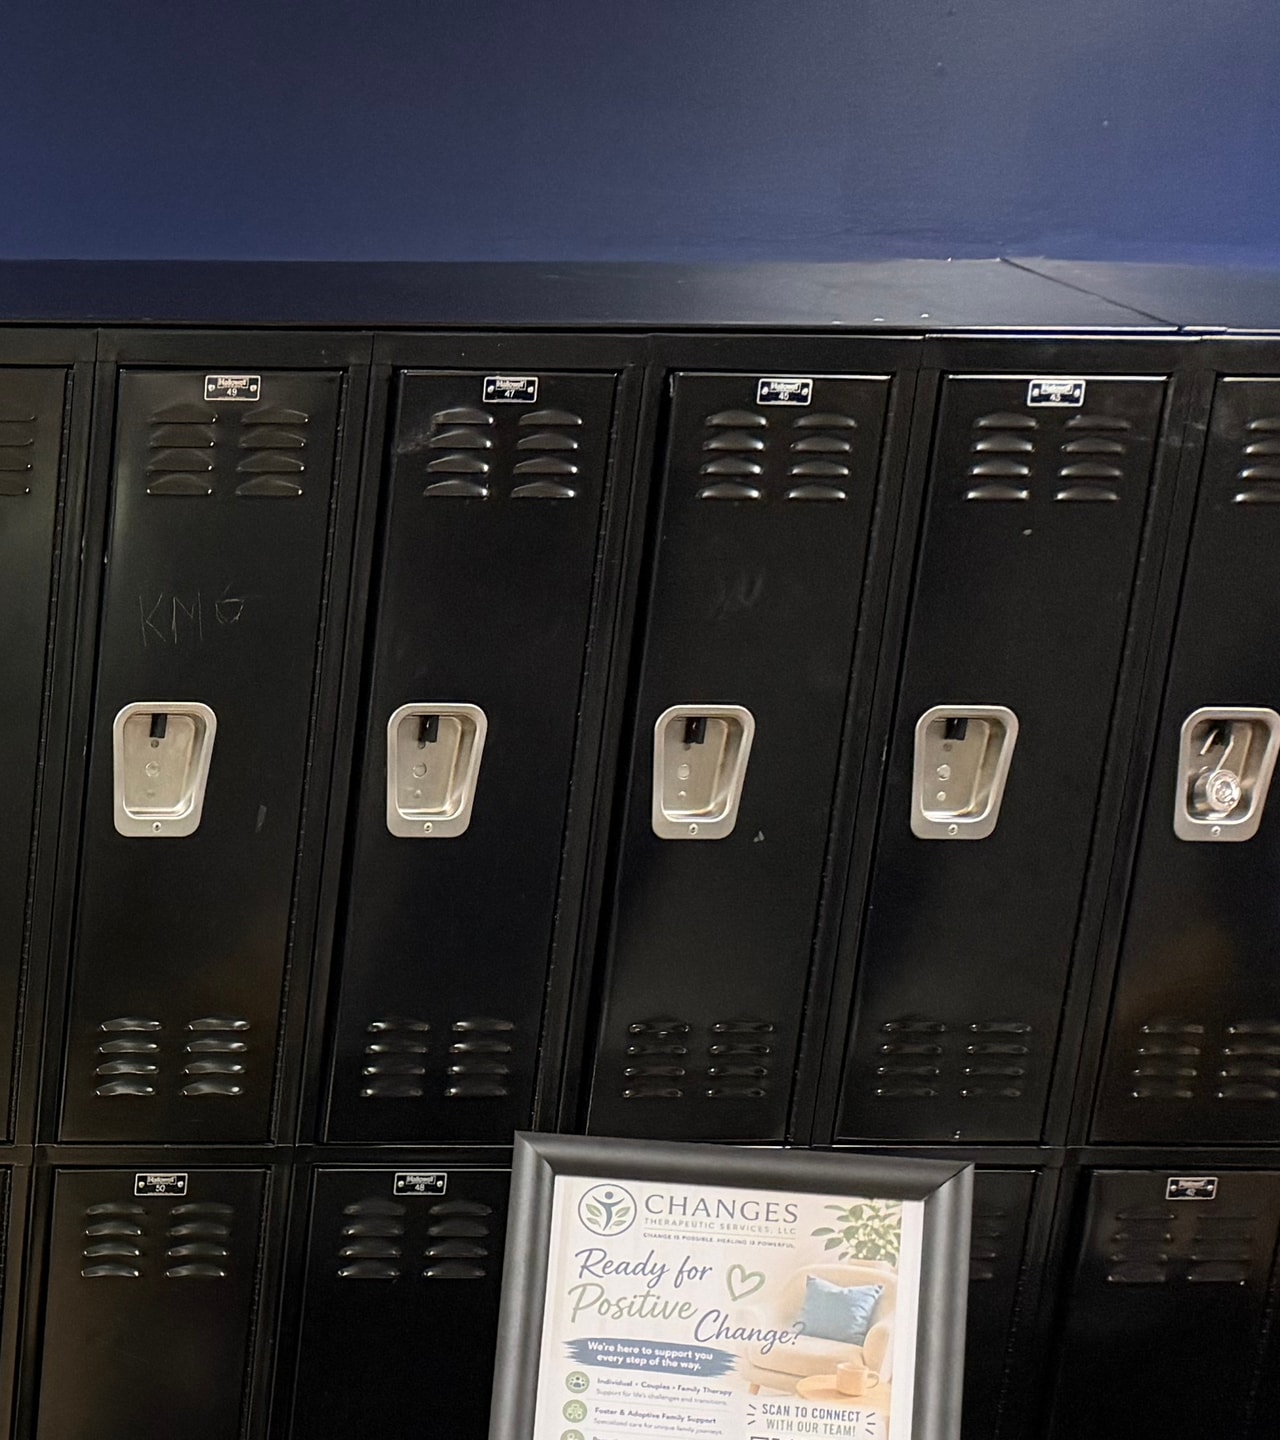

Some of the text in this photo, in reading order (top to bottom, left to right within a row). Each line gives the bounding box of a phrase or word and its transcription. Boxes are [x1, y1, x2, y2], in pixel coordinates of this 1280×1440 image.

[226, 389, 238, 397] 49
[645, 1194, 798, 1224] CHANGES
[644, 1217, 797, 1235] THERAPEUTIC SERVICES, LLC
[574, 1247, 713, 1289] Ready for
[567, 1282, 698, 1324] Positive
[693, 1309, 806, 1355] Change?
[588, 1341, 713, 1362] We're here to support you
[597, 1354, 701, 1371] every step of the way.
[597, 1378, 732, 1397] Individual Couples Family Therapy
[595, 1407, 617, 1416] Foster
[627, 1410, 660, 1420] Adoptive
[662, 1413, 685, 1422] Family
[687, 1415, 716, 1425] Support
[762, 1404, 861, 1422] SCAN TO CONNECT
[766, 1418, 856, 1437] WITH OUR TEAM!
